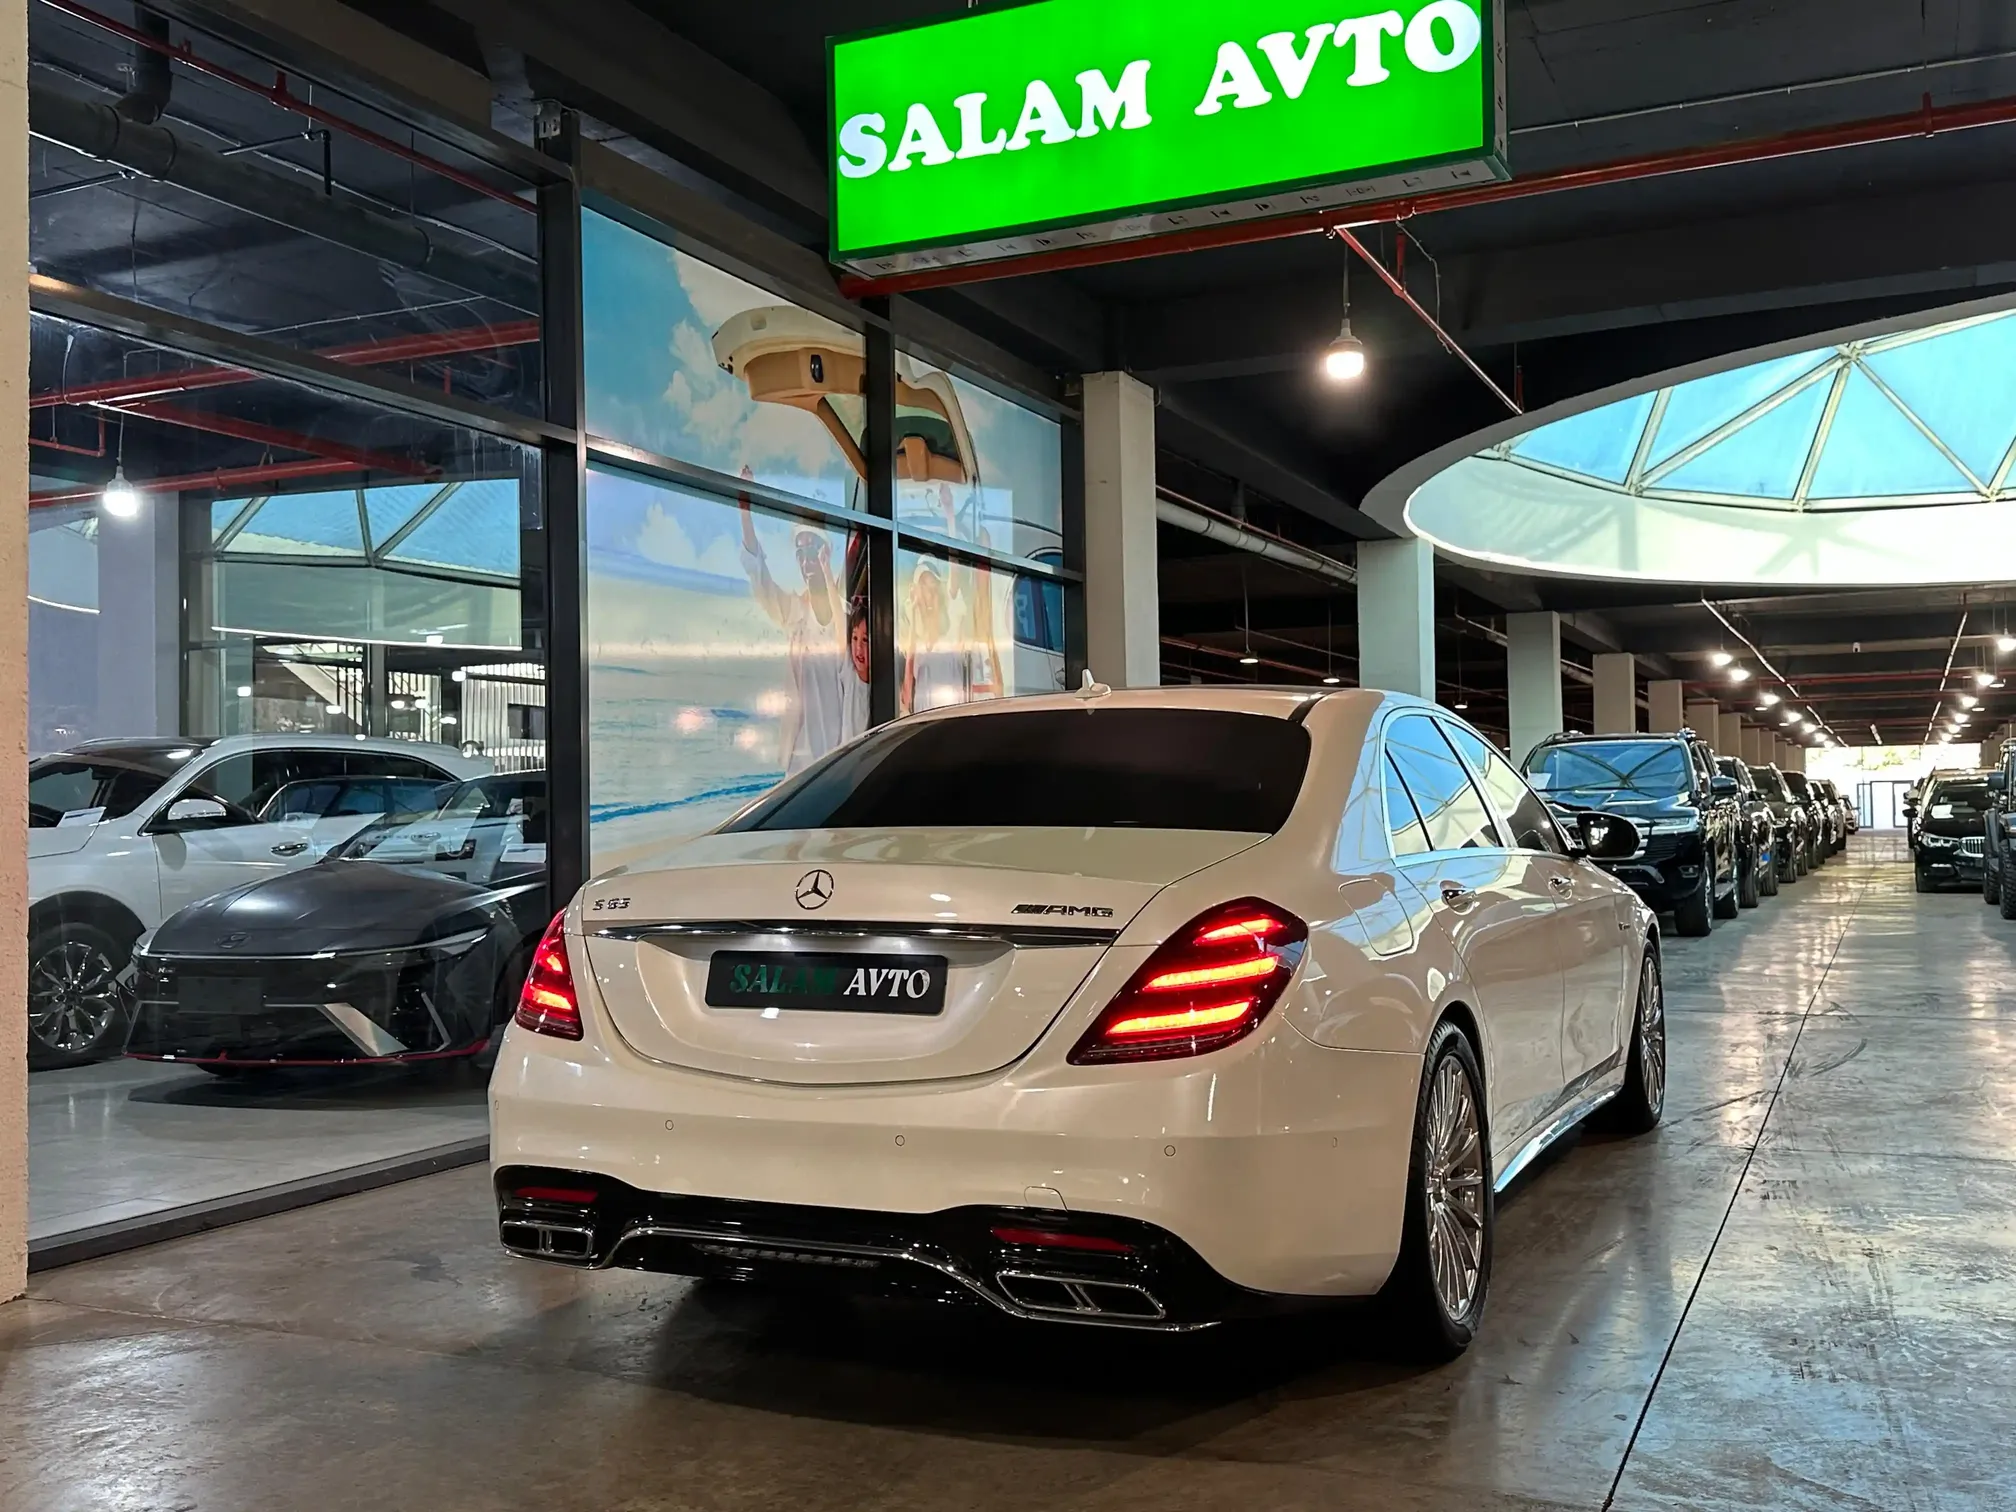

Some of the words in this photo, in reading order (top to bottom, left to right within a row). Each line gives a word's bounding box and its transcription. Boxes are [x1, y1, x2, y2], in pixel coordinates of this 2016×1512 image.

[838, 59, 1151, 178] SALAM
[1195, 0, 1481, 115] AVTO
[592, 899, 606, 911] S
[1043, 904, 1114, 918] AMG
[843, 967, 932, 999] AVTO
